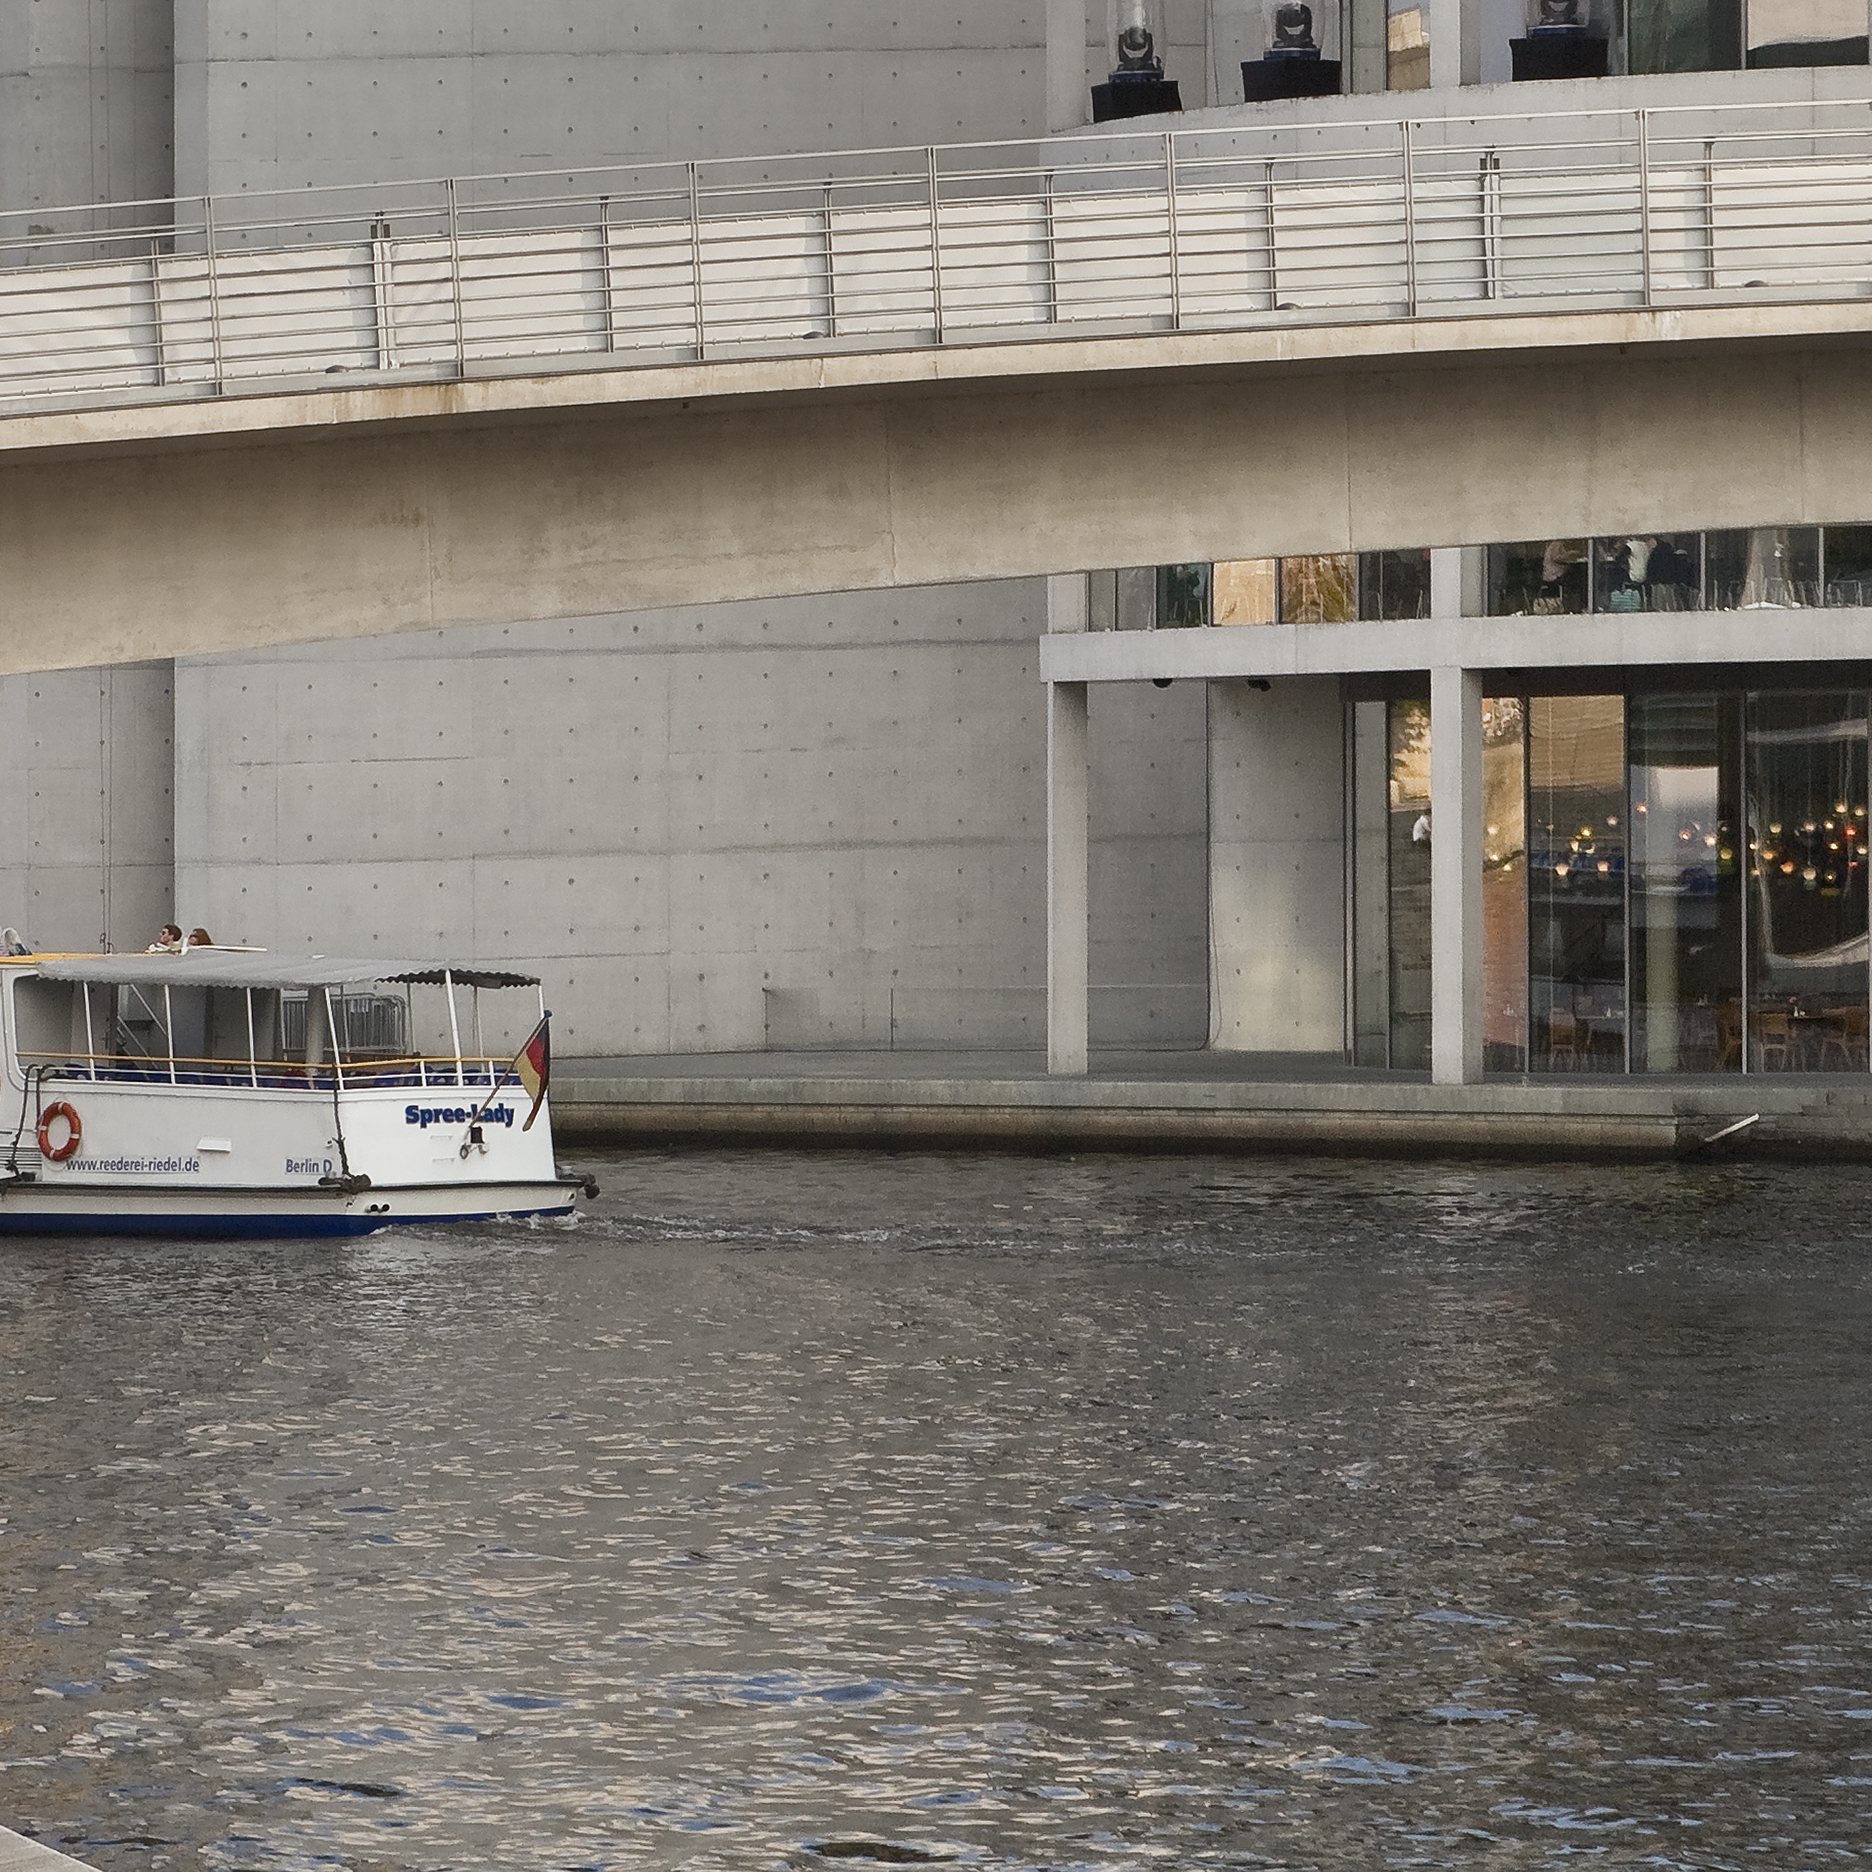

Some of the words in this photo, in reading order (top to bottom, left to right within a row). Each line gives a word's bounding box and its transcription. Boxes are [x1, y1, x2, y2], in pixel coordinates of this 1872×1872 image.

[405, 1103, 514, 1128] Spree-Lady
[66, 1157, 199, 1172] www.reederei-riedel.de
[286, 1159, 319, 1173] Berlin
